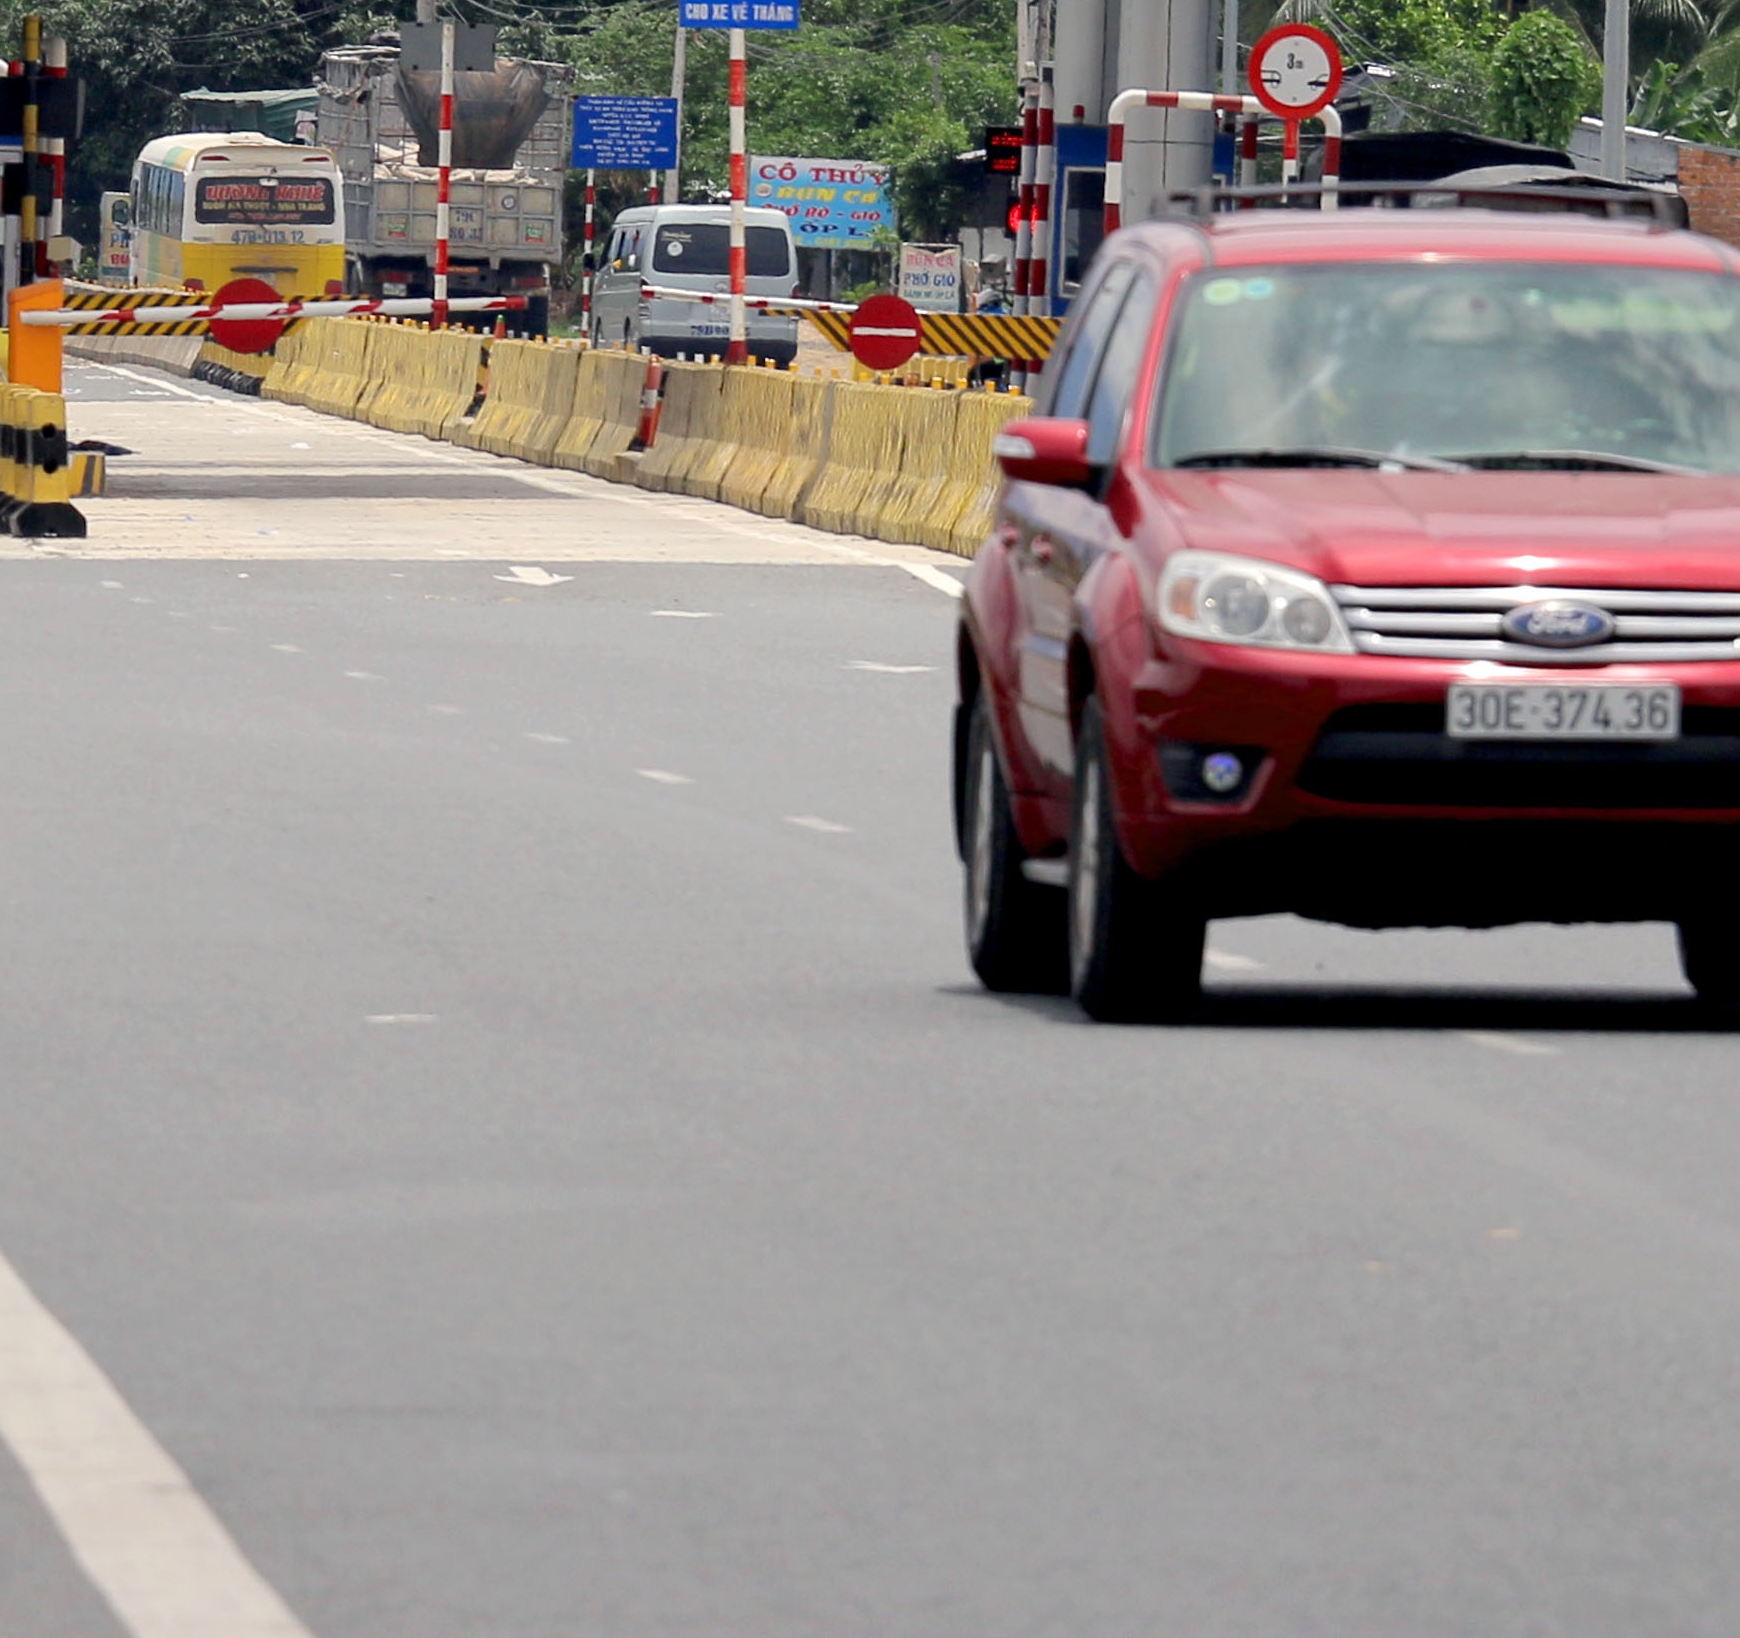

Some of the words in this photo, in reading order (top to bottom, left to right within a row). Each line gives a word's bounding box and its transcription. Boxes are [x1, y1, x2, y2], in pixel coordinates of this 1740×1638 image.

[685, 3, 708, 20] CHO
[712, 4, 729, 20] XE
[759, 162, 797, 181] CÔ
[1457, 689, 1670, 731] 30E-374.36
